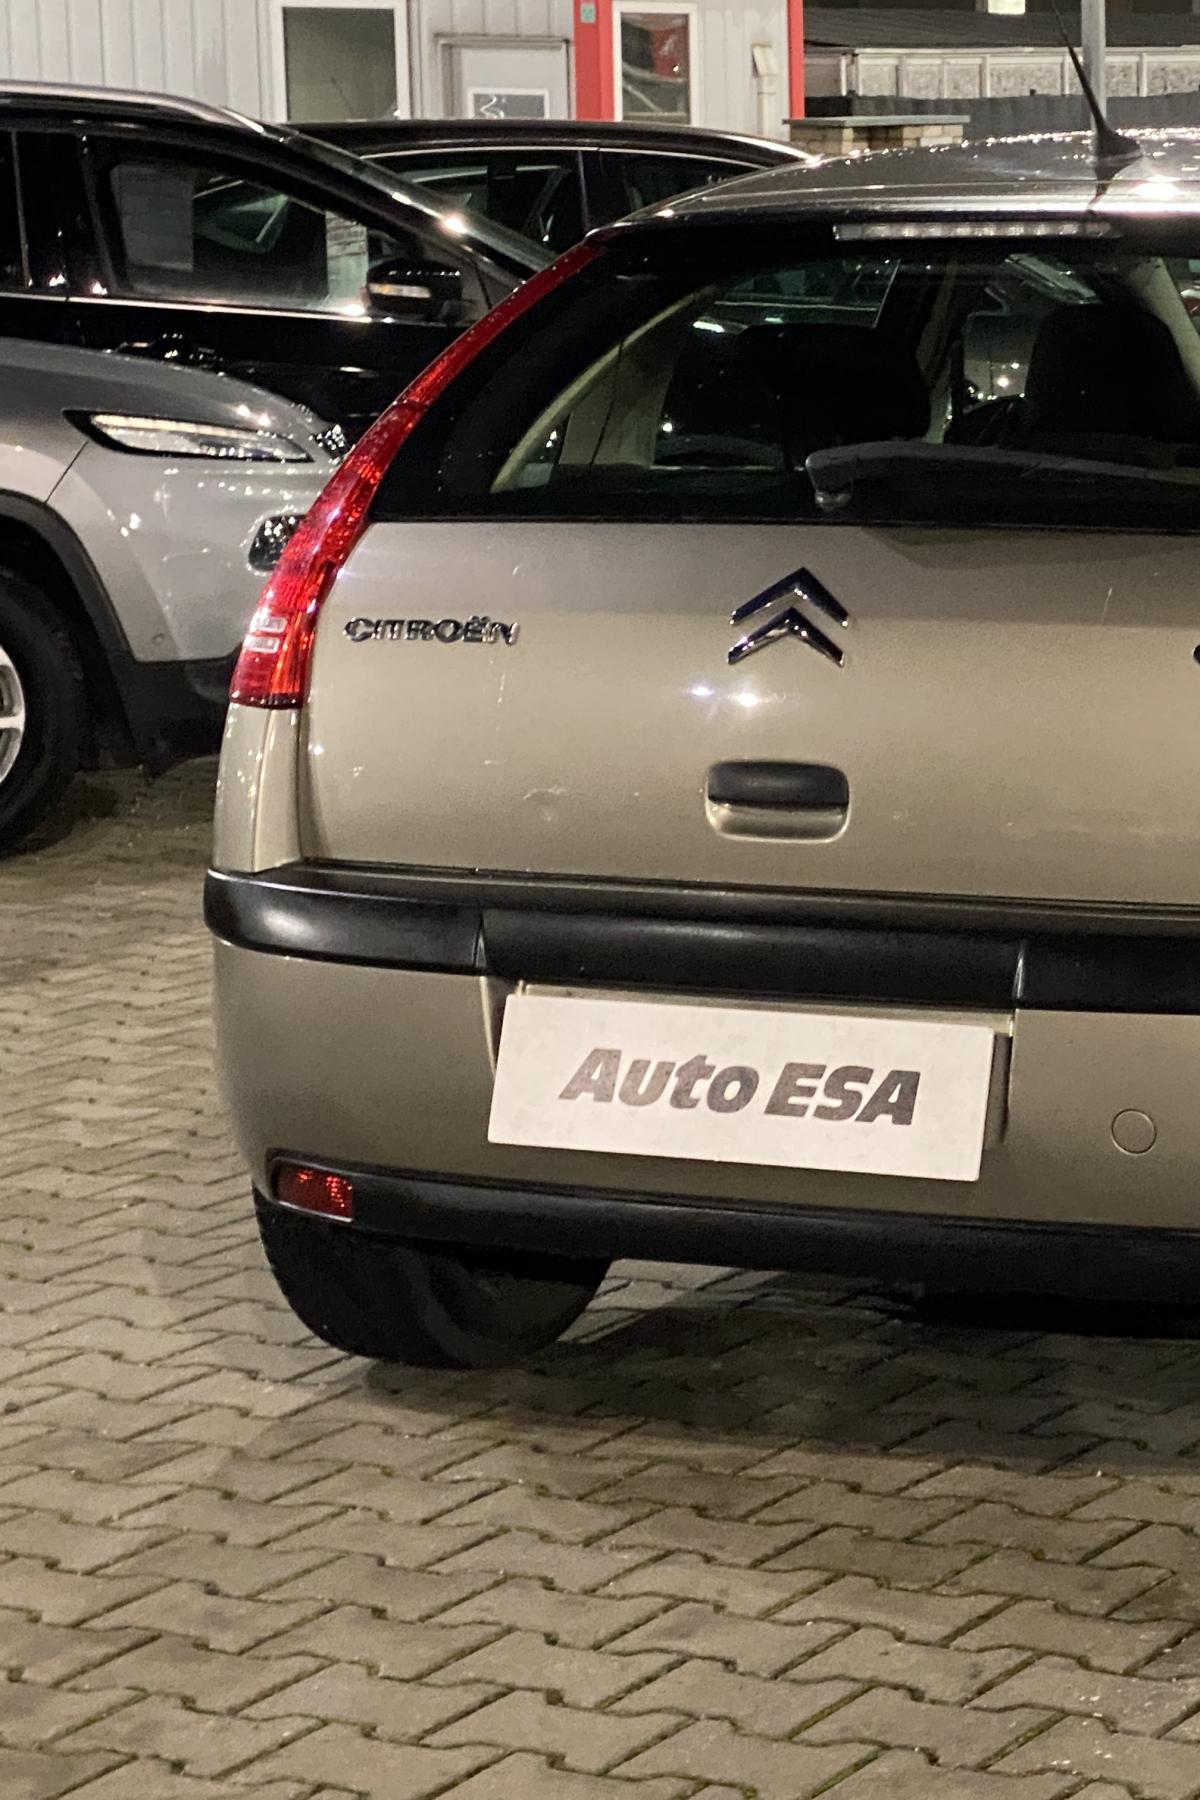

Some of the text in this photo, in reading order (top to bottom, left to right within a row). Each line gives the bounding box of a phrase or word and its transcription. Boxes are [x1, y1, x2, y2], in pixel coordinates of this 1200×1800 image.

[343, 615, 521, 646] CITROËN
[558, 1047, 921, 1126] Auto ESA
